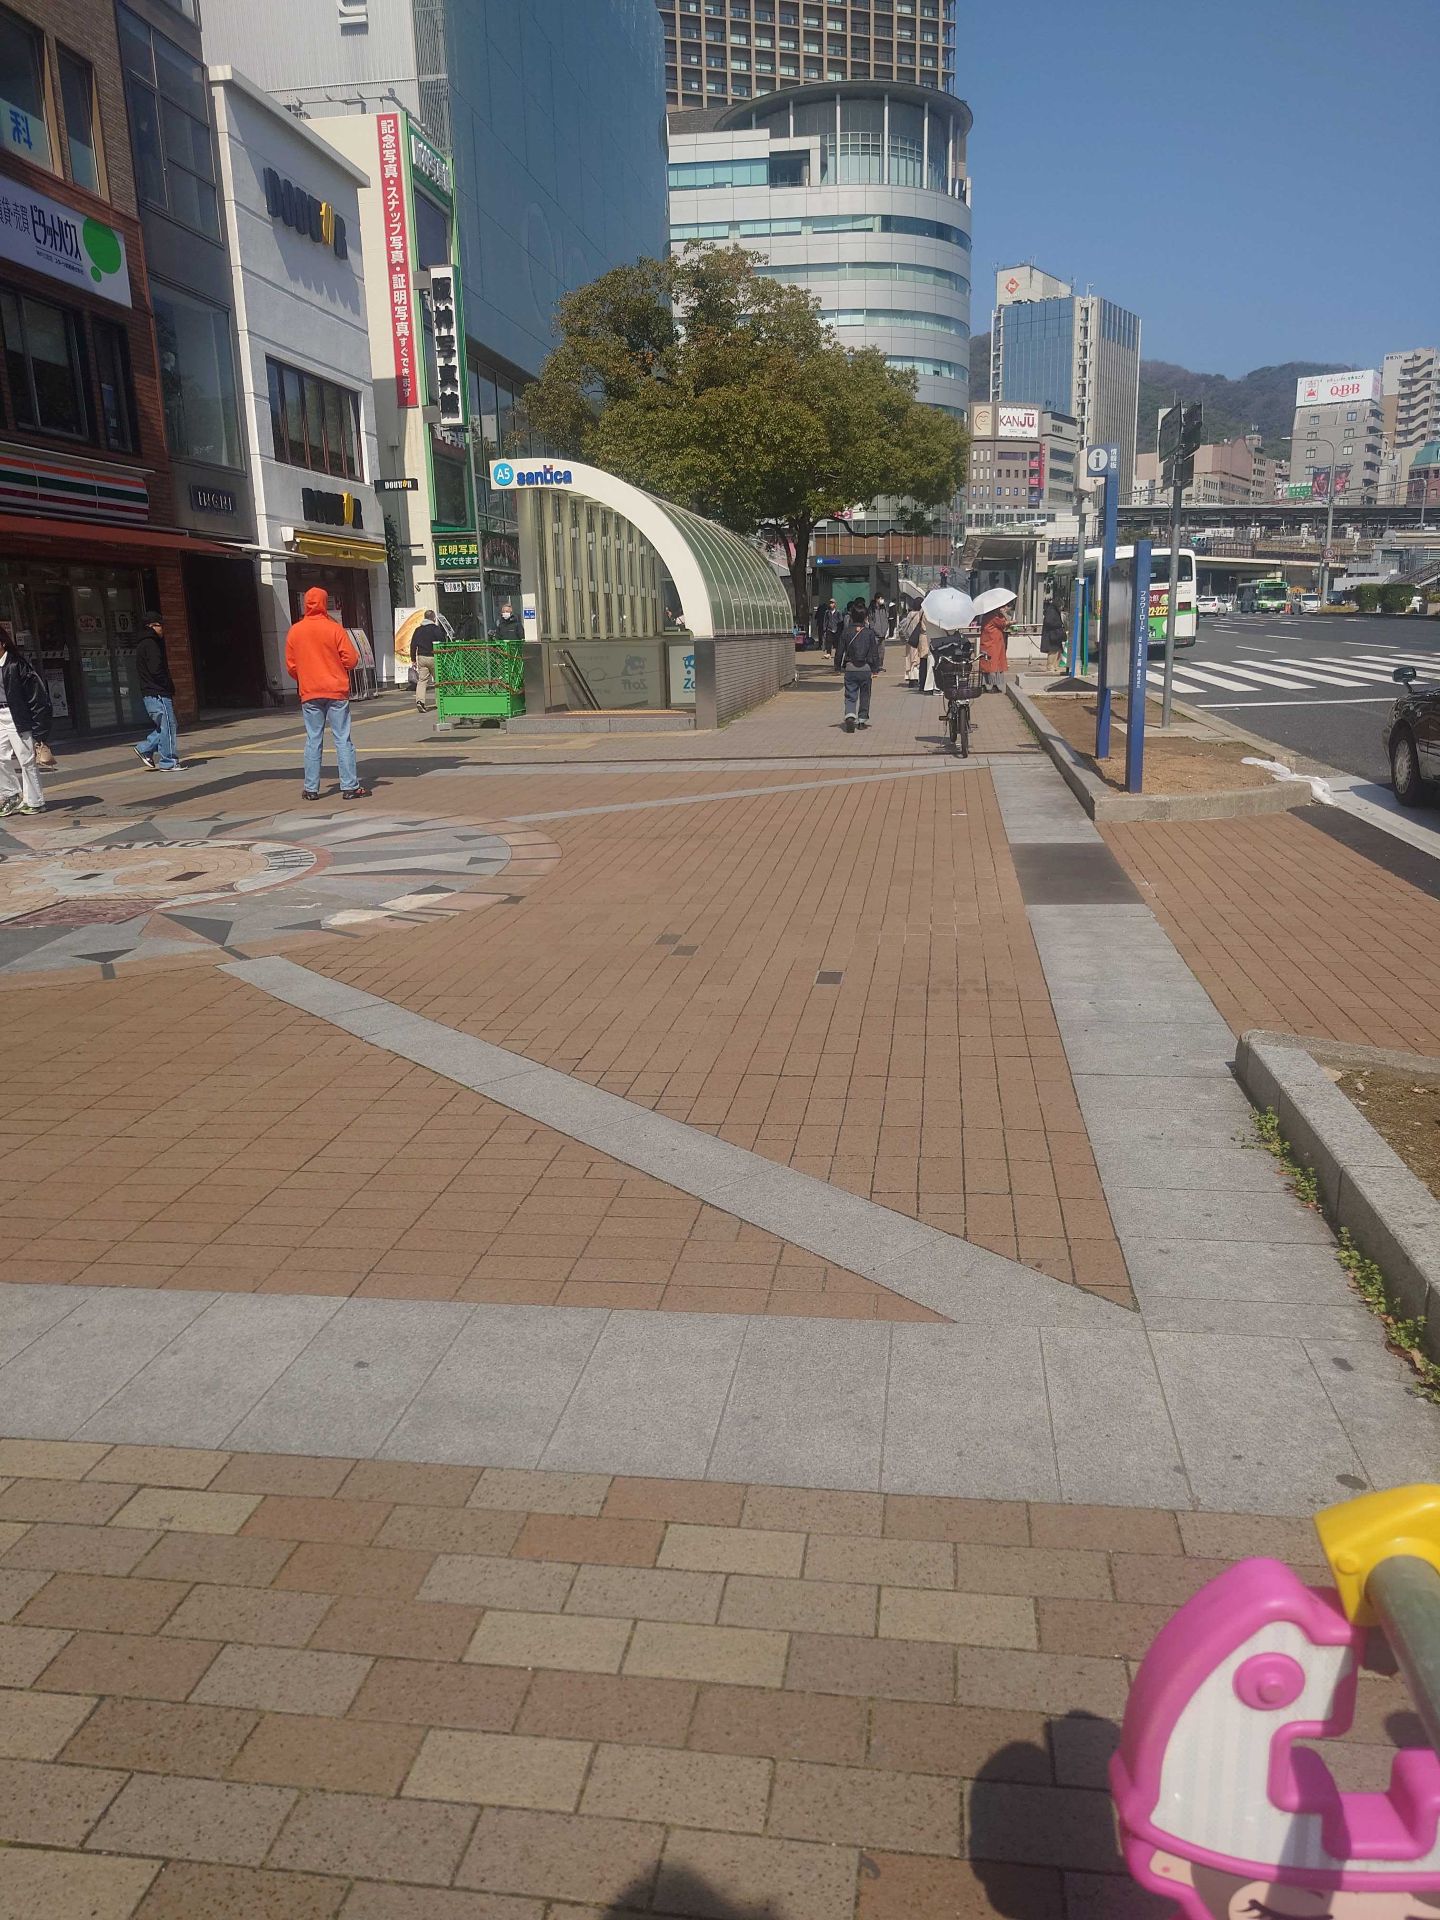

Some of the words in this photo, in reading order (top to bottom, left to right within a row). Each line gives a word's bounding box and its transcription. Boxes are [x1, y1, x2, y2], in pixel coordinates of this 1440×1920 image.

[9, 110, 33, 150] 科
[30, 204, 82, 261] ピタットハウス
[497, 468, 511, 480] A5
[516, 464, 573, 486] santica
[438, 544, 478, 556] 証明写真
